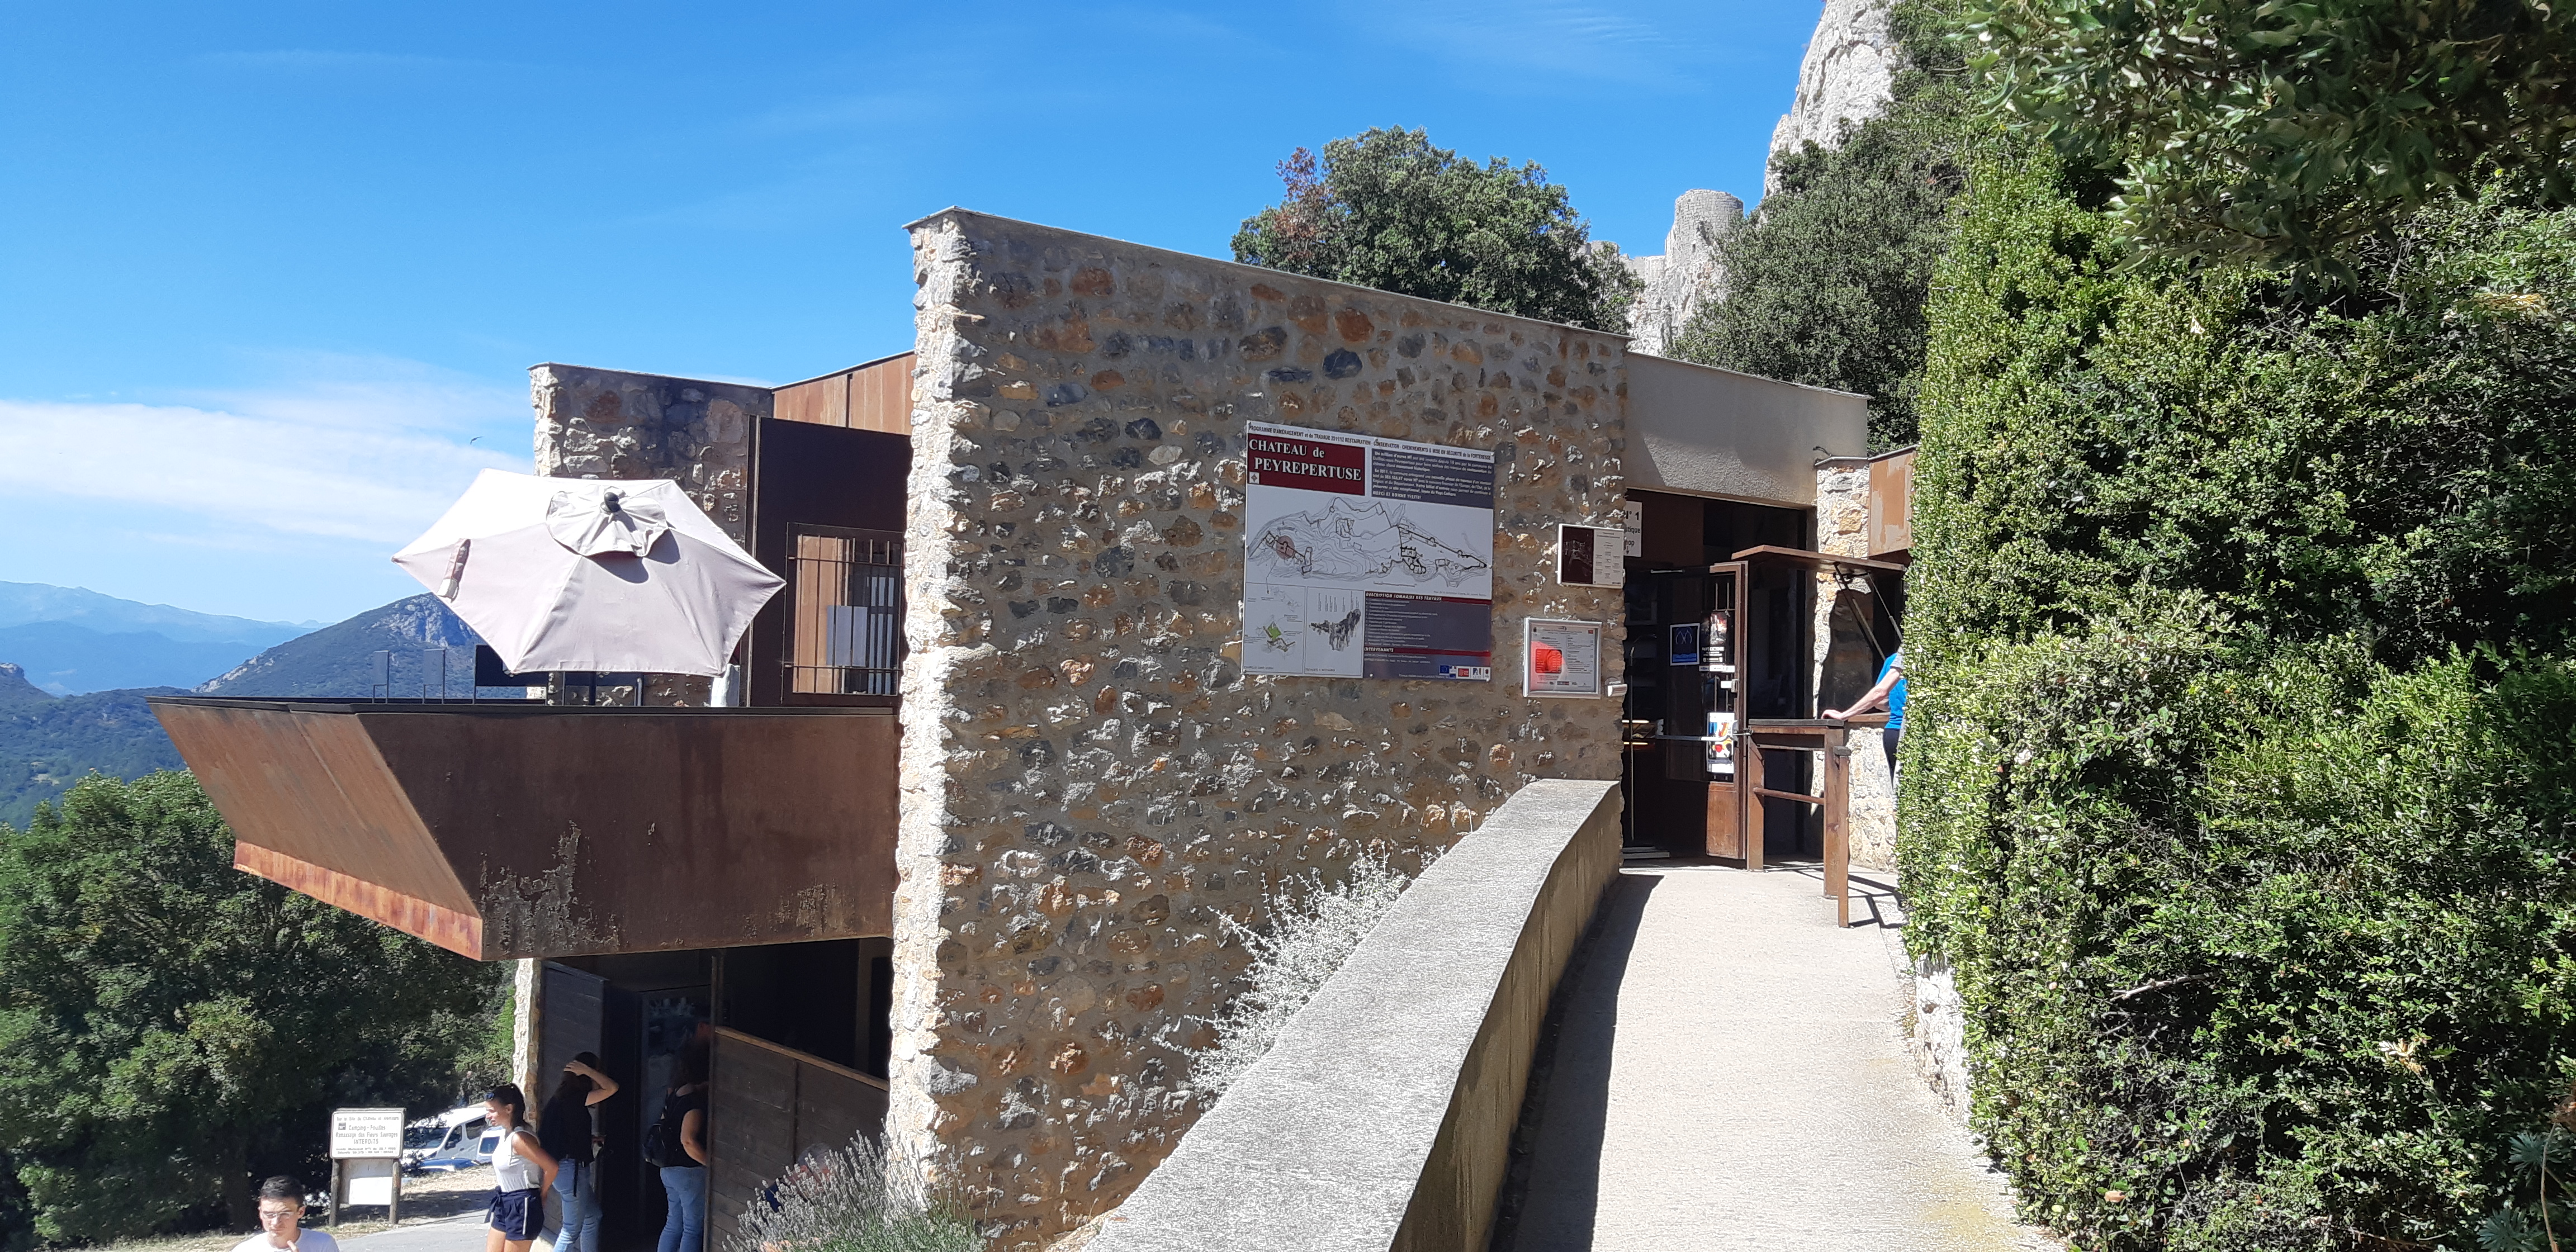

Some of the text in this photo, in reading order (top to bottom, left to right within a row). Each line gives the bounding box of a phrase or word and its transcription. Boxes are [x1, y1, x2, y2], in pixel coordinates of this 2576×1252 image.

[1249, 439, 1325, 458] CHATEAU de
[1254, 457, 1361, 481] PEYREPERTUSE
[1635, 511, 1639, 520] 1
